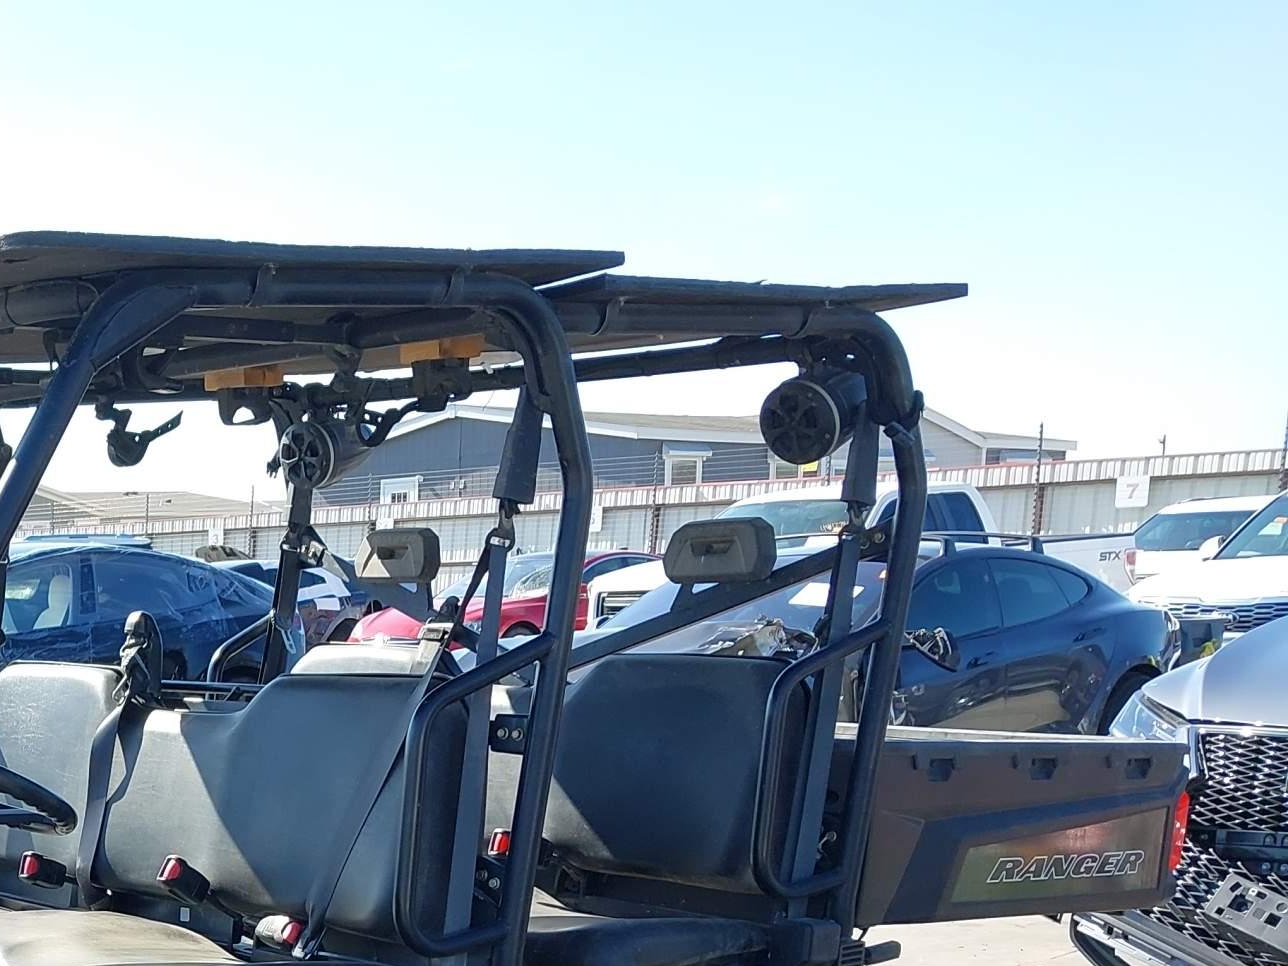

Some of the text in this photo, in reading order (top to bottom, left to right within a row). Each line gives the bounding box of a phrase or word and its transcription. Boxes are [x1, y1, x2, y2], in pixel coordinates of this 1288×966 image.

[1126, 483, 1139, 499] 7
[1098, 550, 1122, 561] STX
[986, 850, 1145, 884] RANGER
